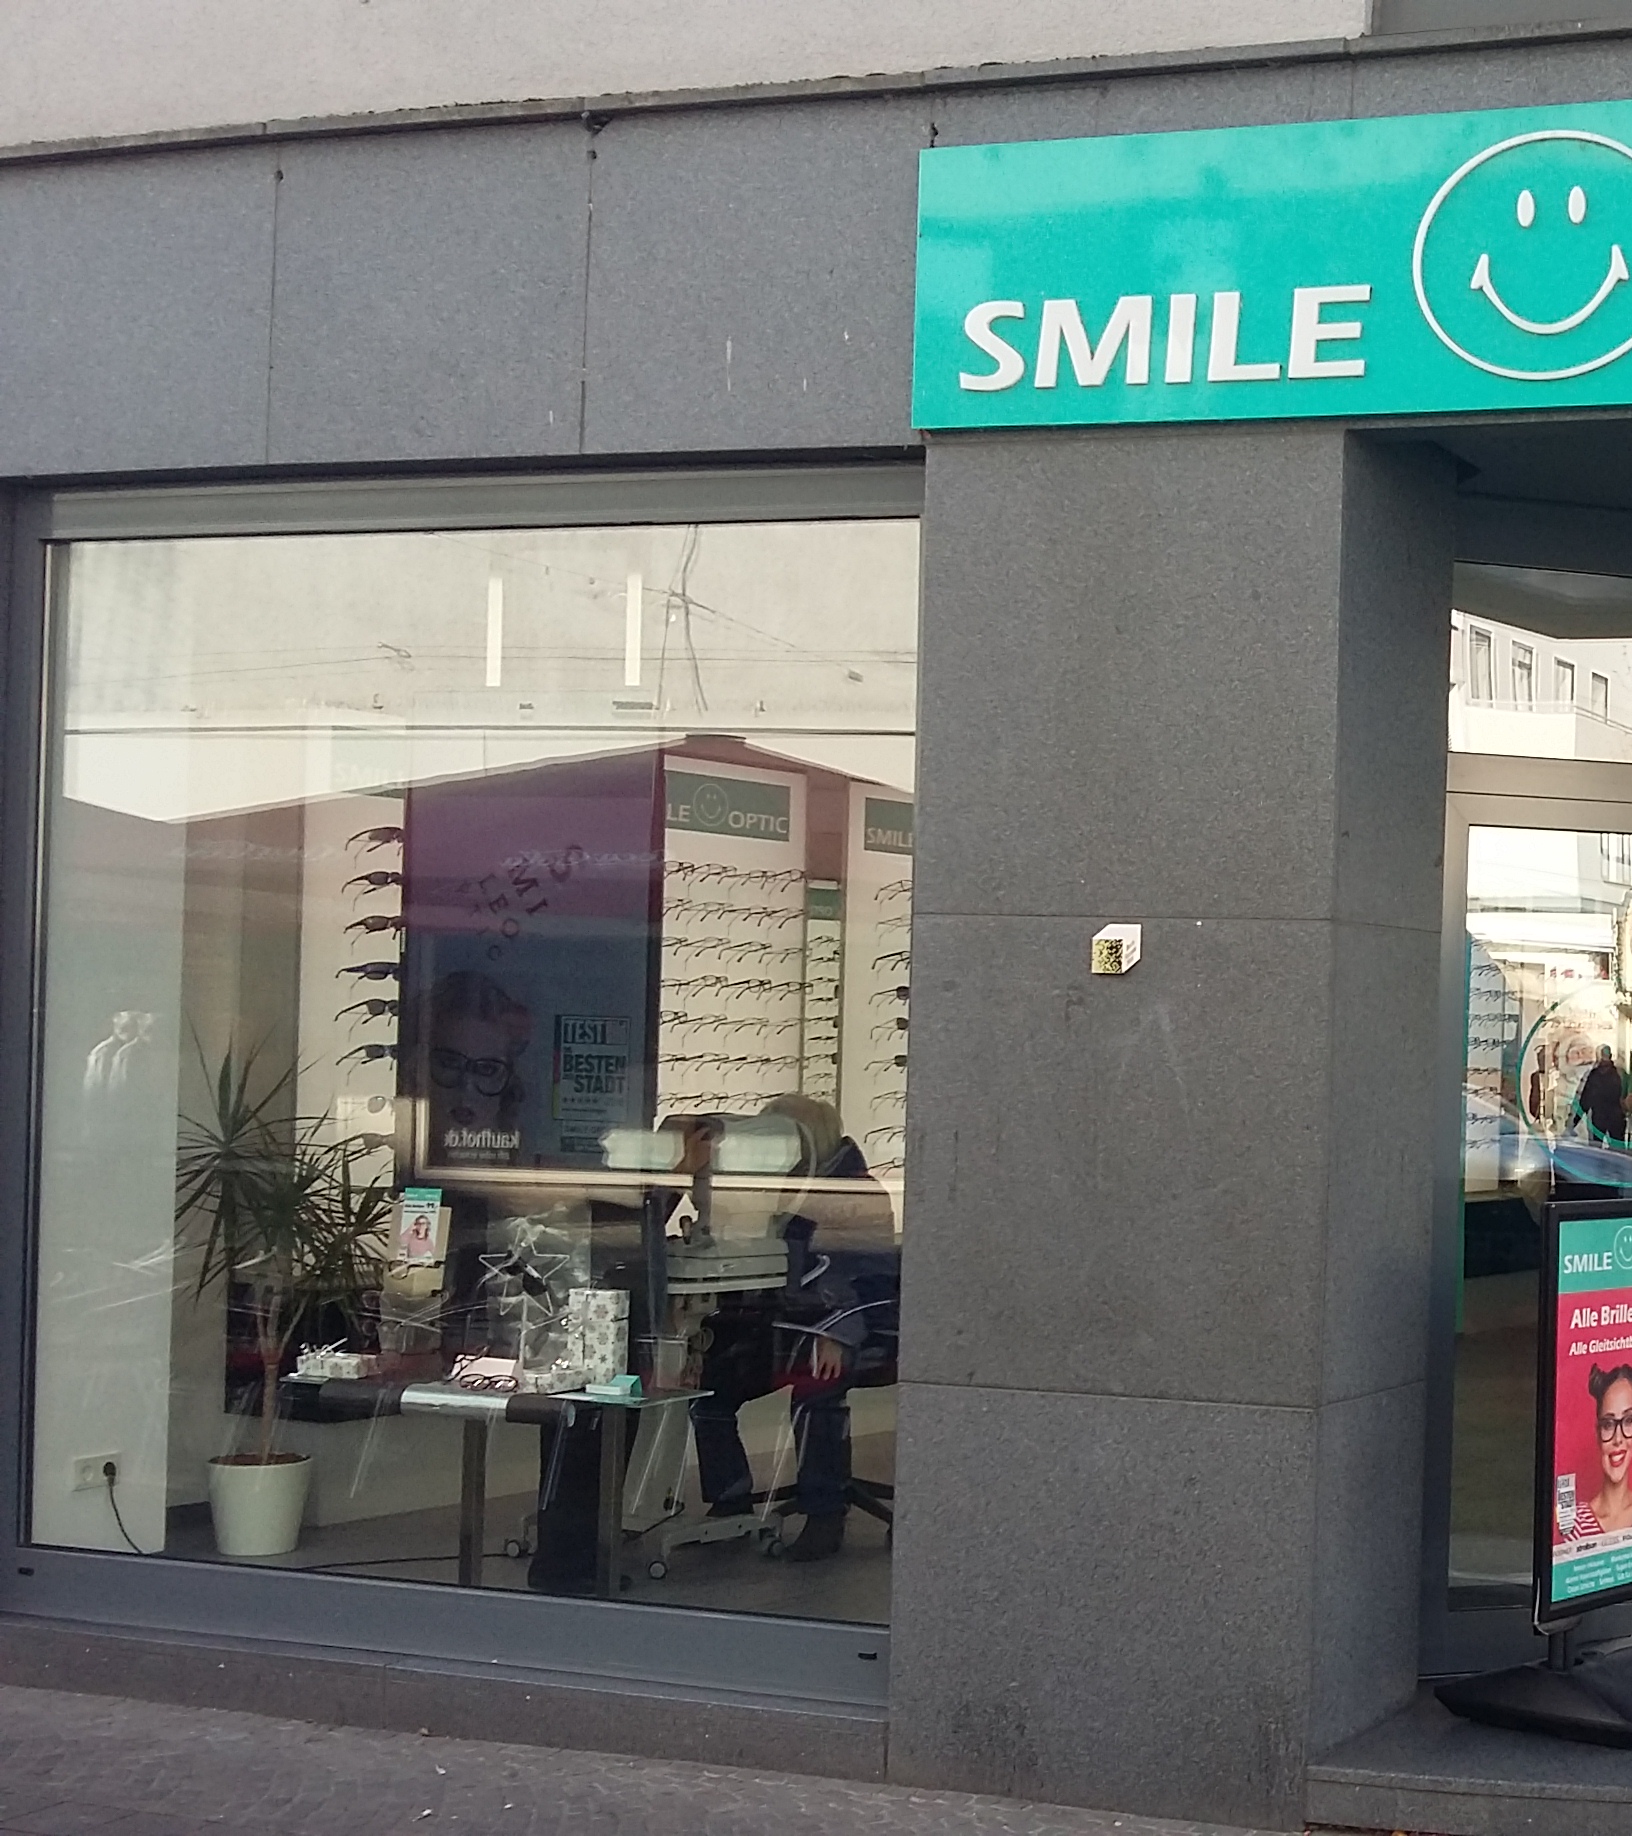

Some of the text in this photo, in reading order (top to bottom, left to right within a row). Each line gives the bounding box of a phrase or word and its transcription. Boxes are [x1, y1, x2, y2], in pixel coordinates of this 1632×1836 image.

[958, 284, 1374, 392] SMILE
[728, 811, 788, 833] OPTIC
[563, 1054, 626, 1074] BESTEN
[574, 1074, 625, 1094] STADT
[1563, 1252, 1613, 1274] SMILE
[1569, 1308, 1598, 1330] Alle
[1568, 1341, 1588, 1357] Alle
